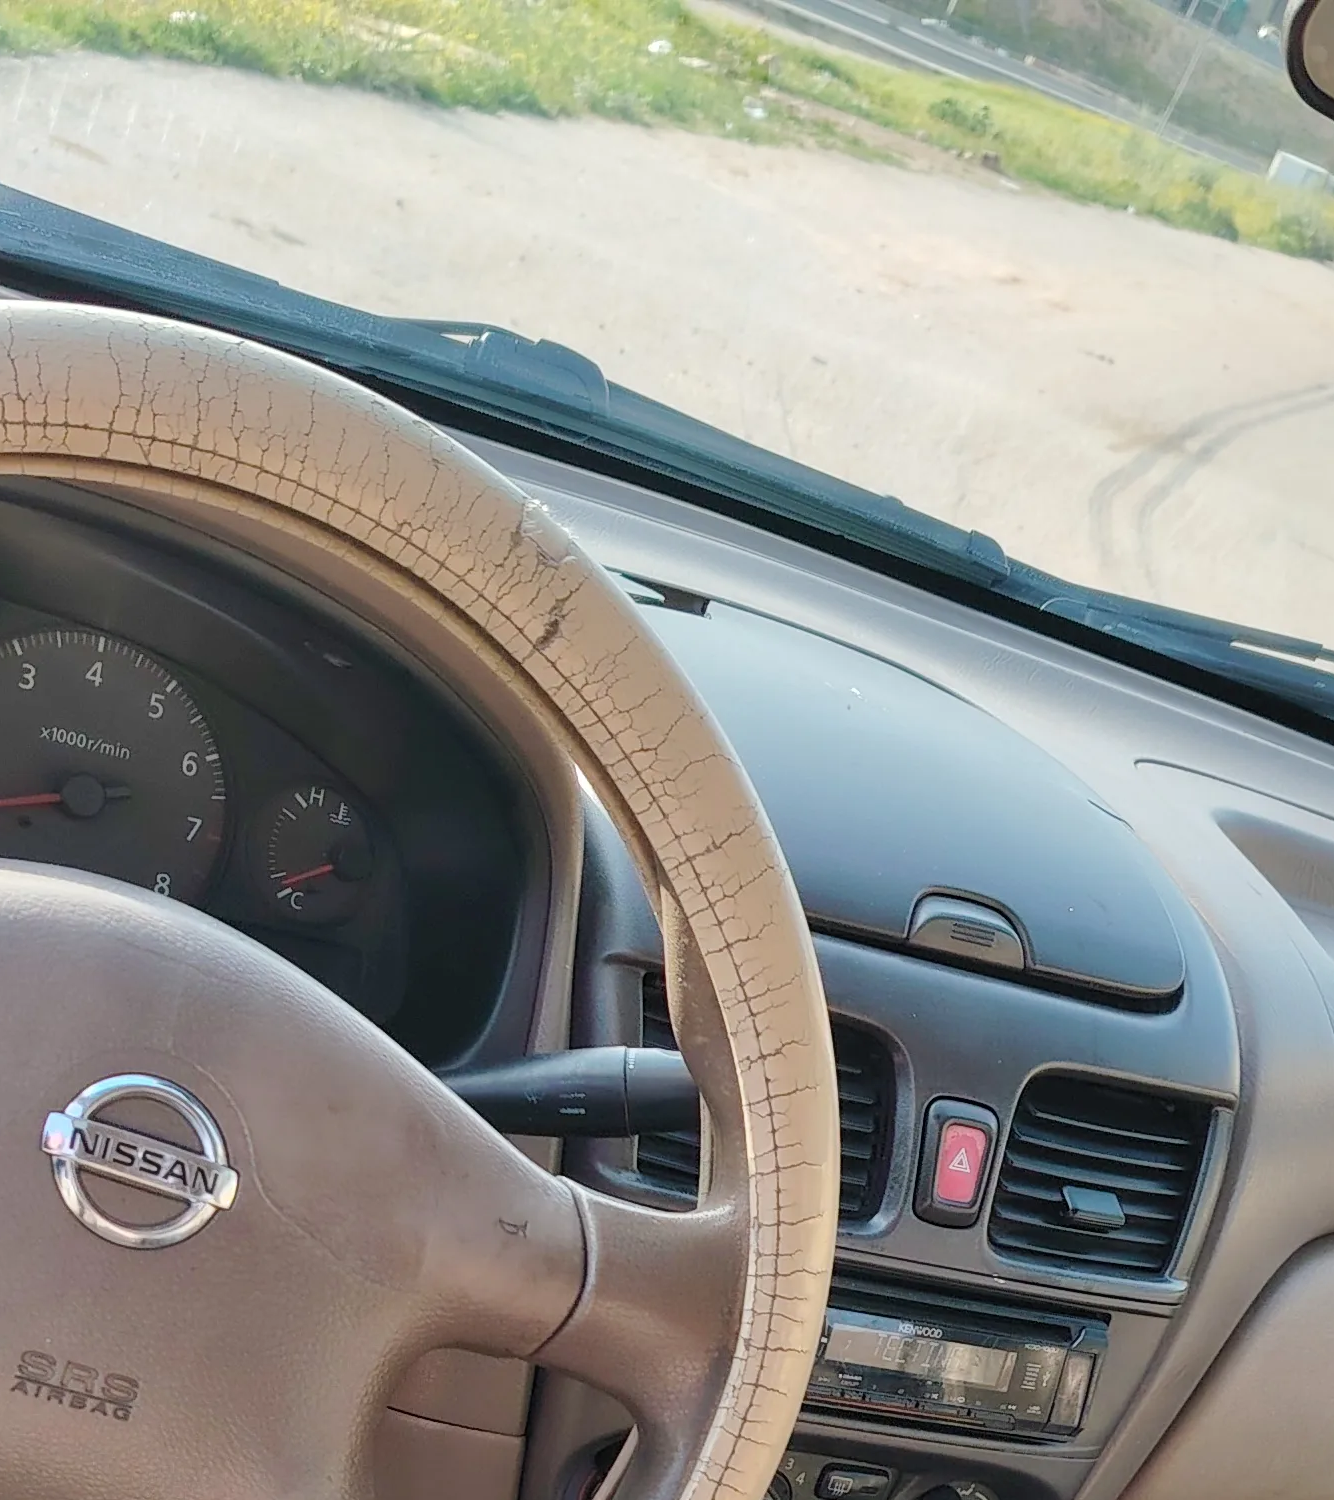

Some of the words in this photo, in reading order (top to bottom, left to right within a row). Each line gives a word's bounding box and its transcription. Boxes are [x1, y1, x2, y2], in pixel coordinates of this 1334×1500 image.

[18, 663, 37, 690] 3
[85, 660, 104, 687] 4
[147, 693, 165, 719] 5
[181, 751, 199, 777] 6
[308, 786, 326, 808] H
[185, 816, 203, 842] 7
[153, 873, 171, 895] 8
[290, 890, 305, 911] C
[69, 1126, 219, 1195] NISSAN
[898, 1321, 943, 1339] KENWOOD
[17, 1350, 141, 1403] SRS
[10, 1379, 132, 1422] AIRBAG
[784, 1457, 795, 1471] 3
[796, 1471, 806, 1486] 4
